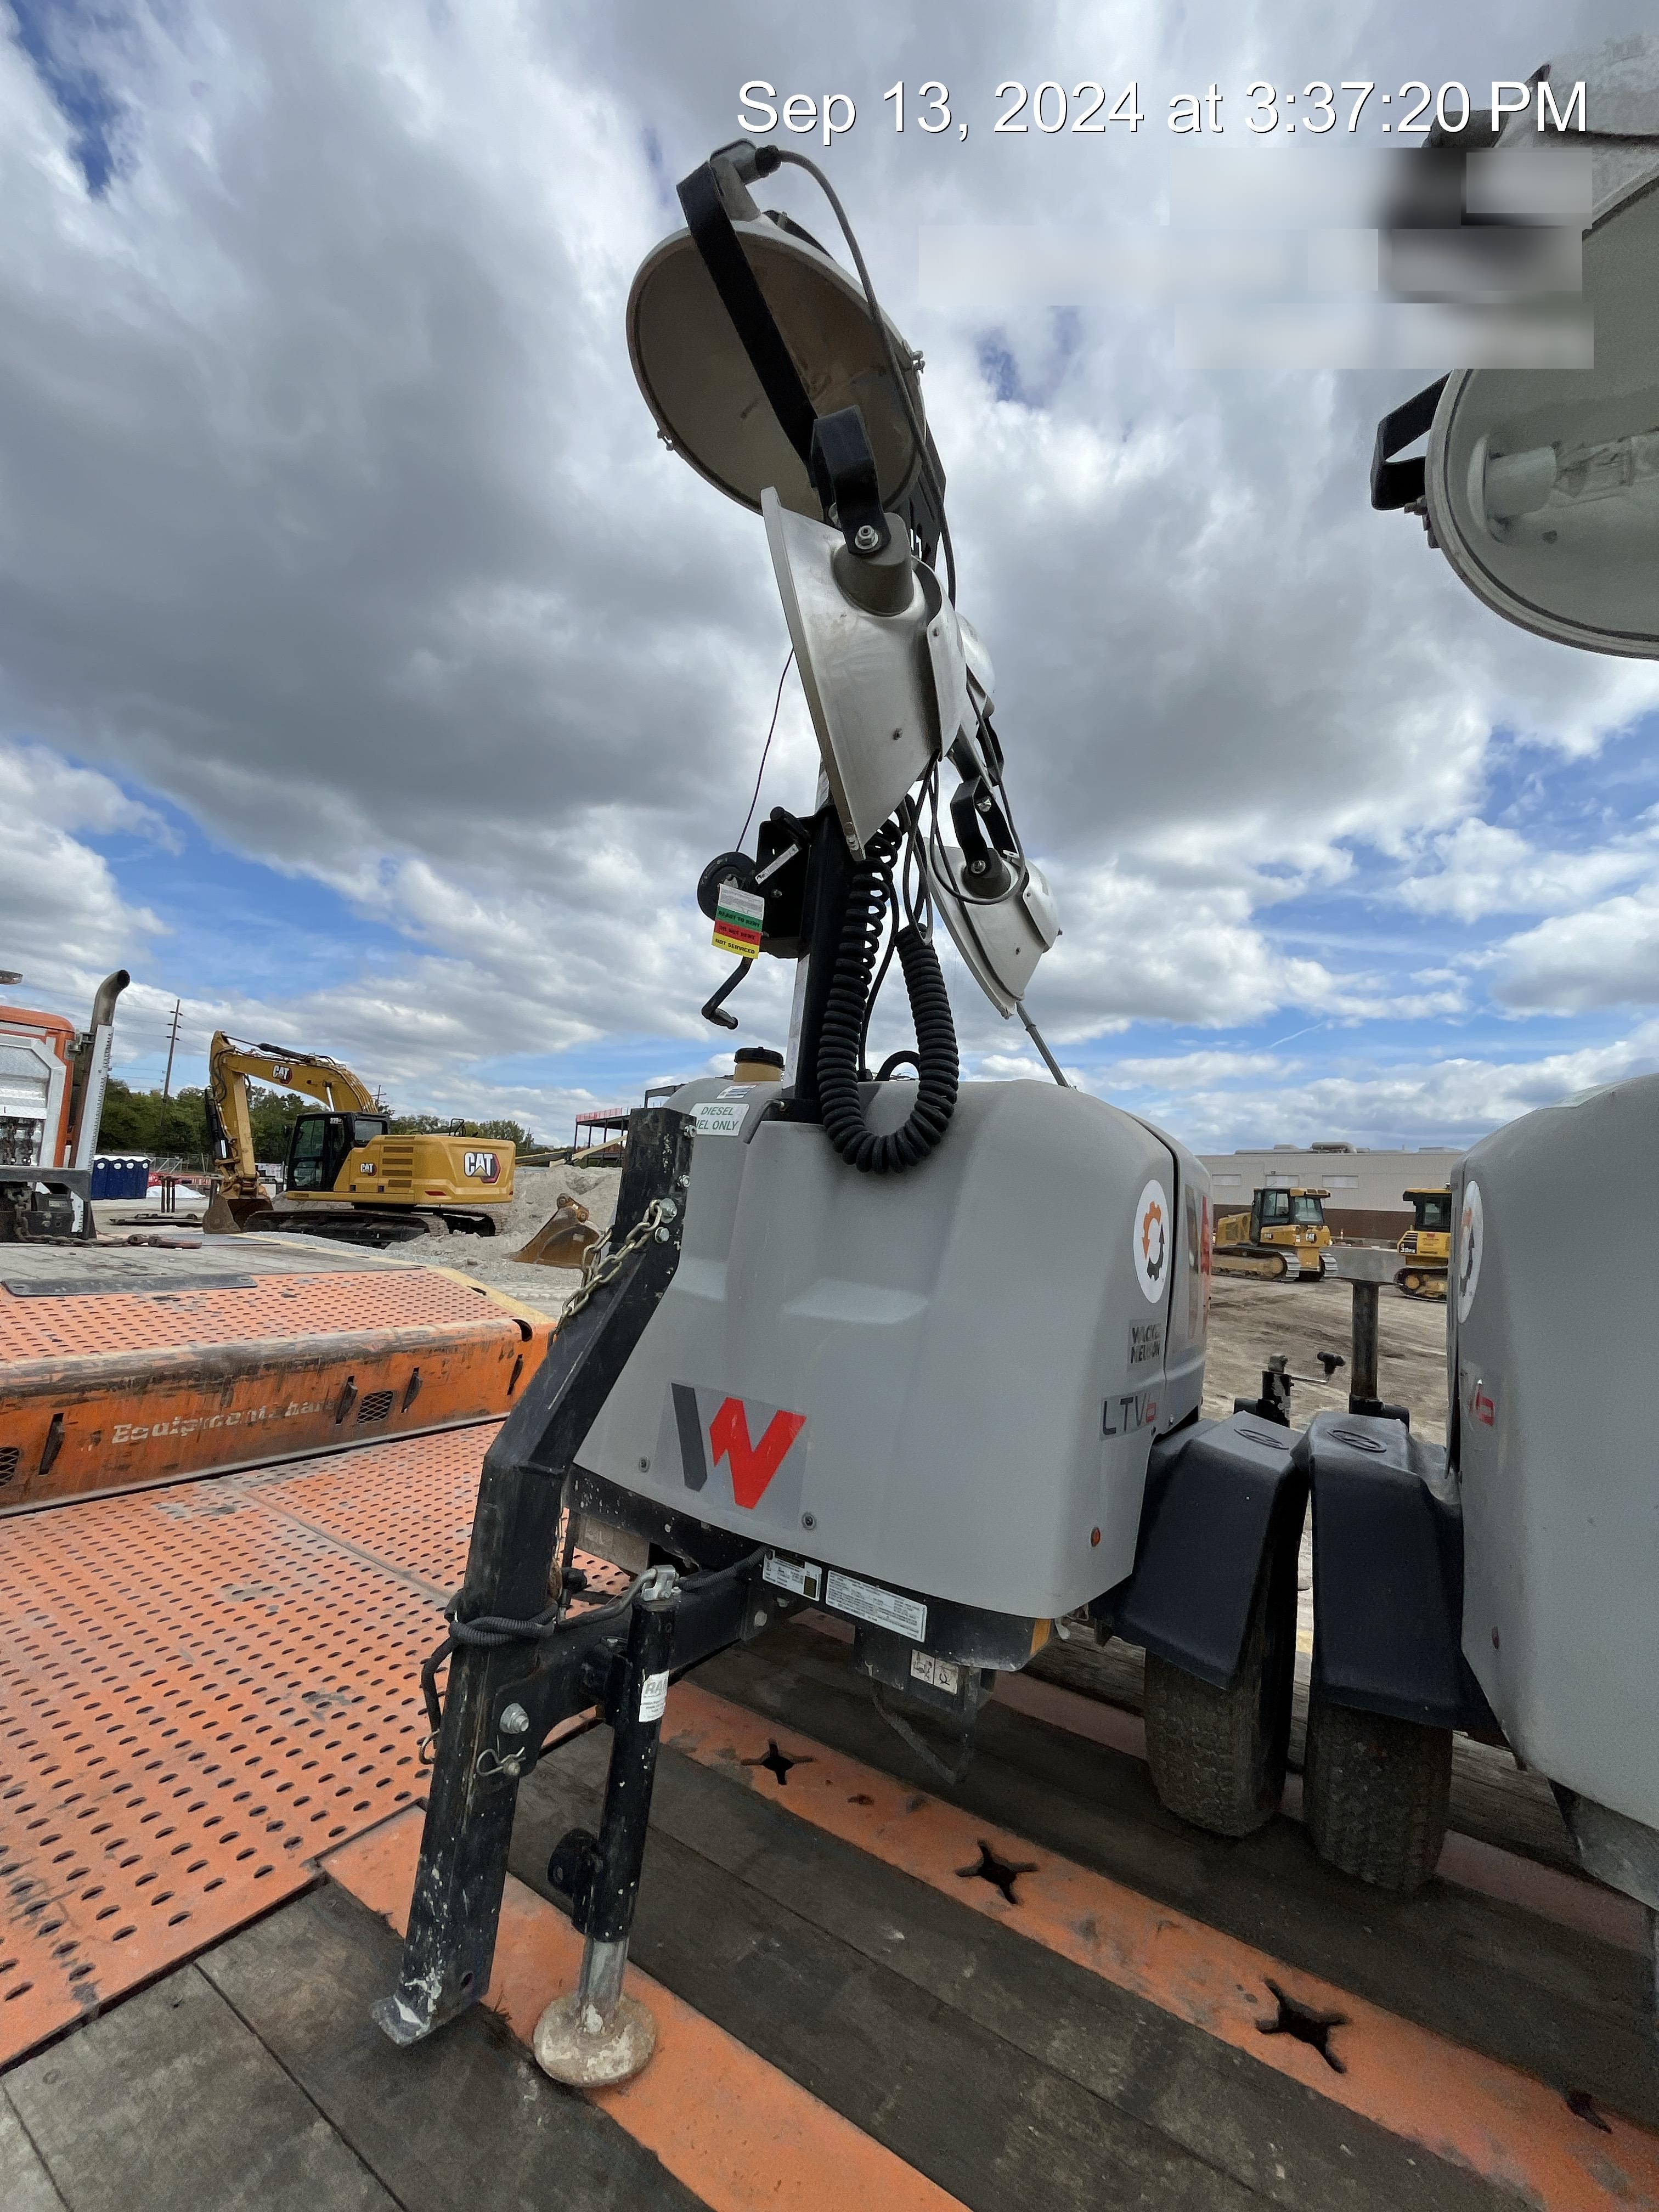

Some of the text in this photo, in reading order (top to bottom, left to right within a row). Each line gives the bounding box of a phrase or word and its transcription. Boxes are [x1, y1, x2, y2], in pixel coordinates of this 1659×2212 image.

[728, 942, 755, 954] SERVICED
[273, 1065, 290, 1080] CAT
[701, 1107, 733, 1115] DIESEL
[712, 1120, 739, 1130] ONLY
[360, 1163, 374, 1173] CAT
[465, 1152, 493, 1177] CAT
